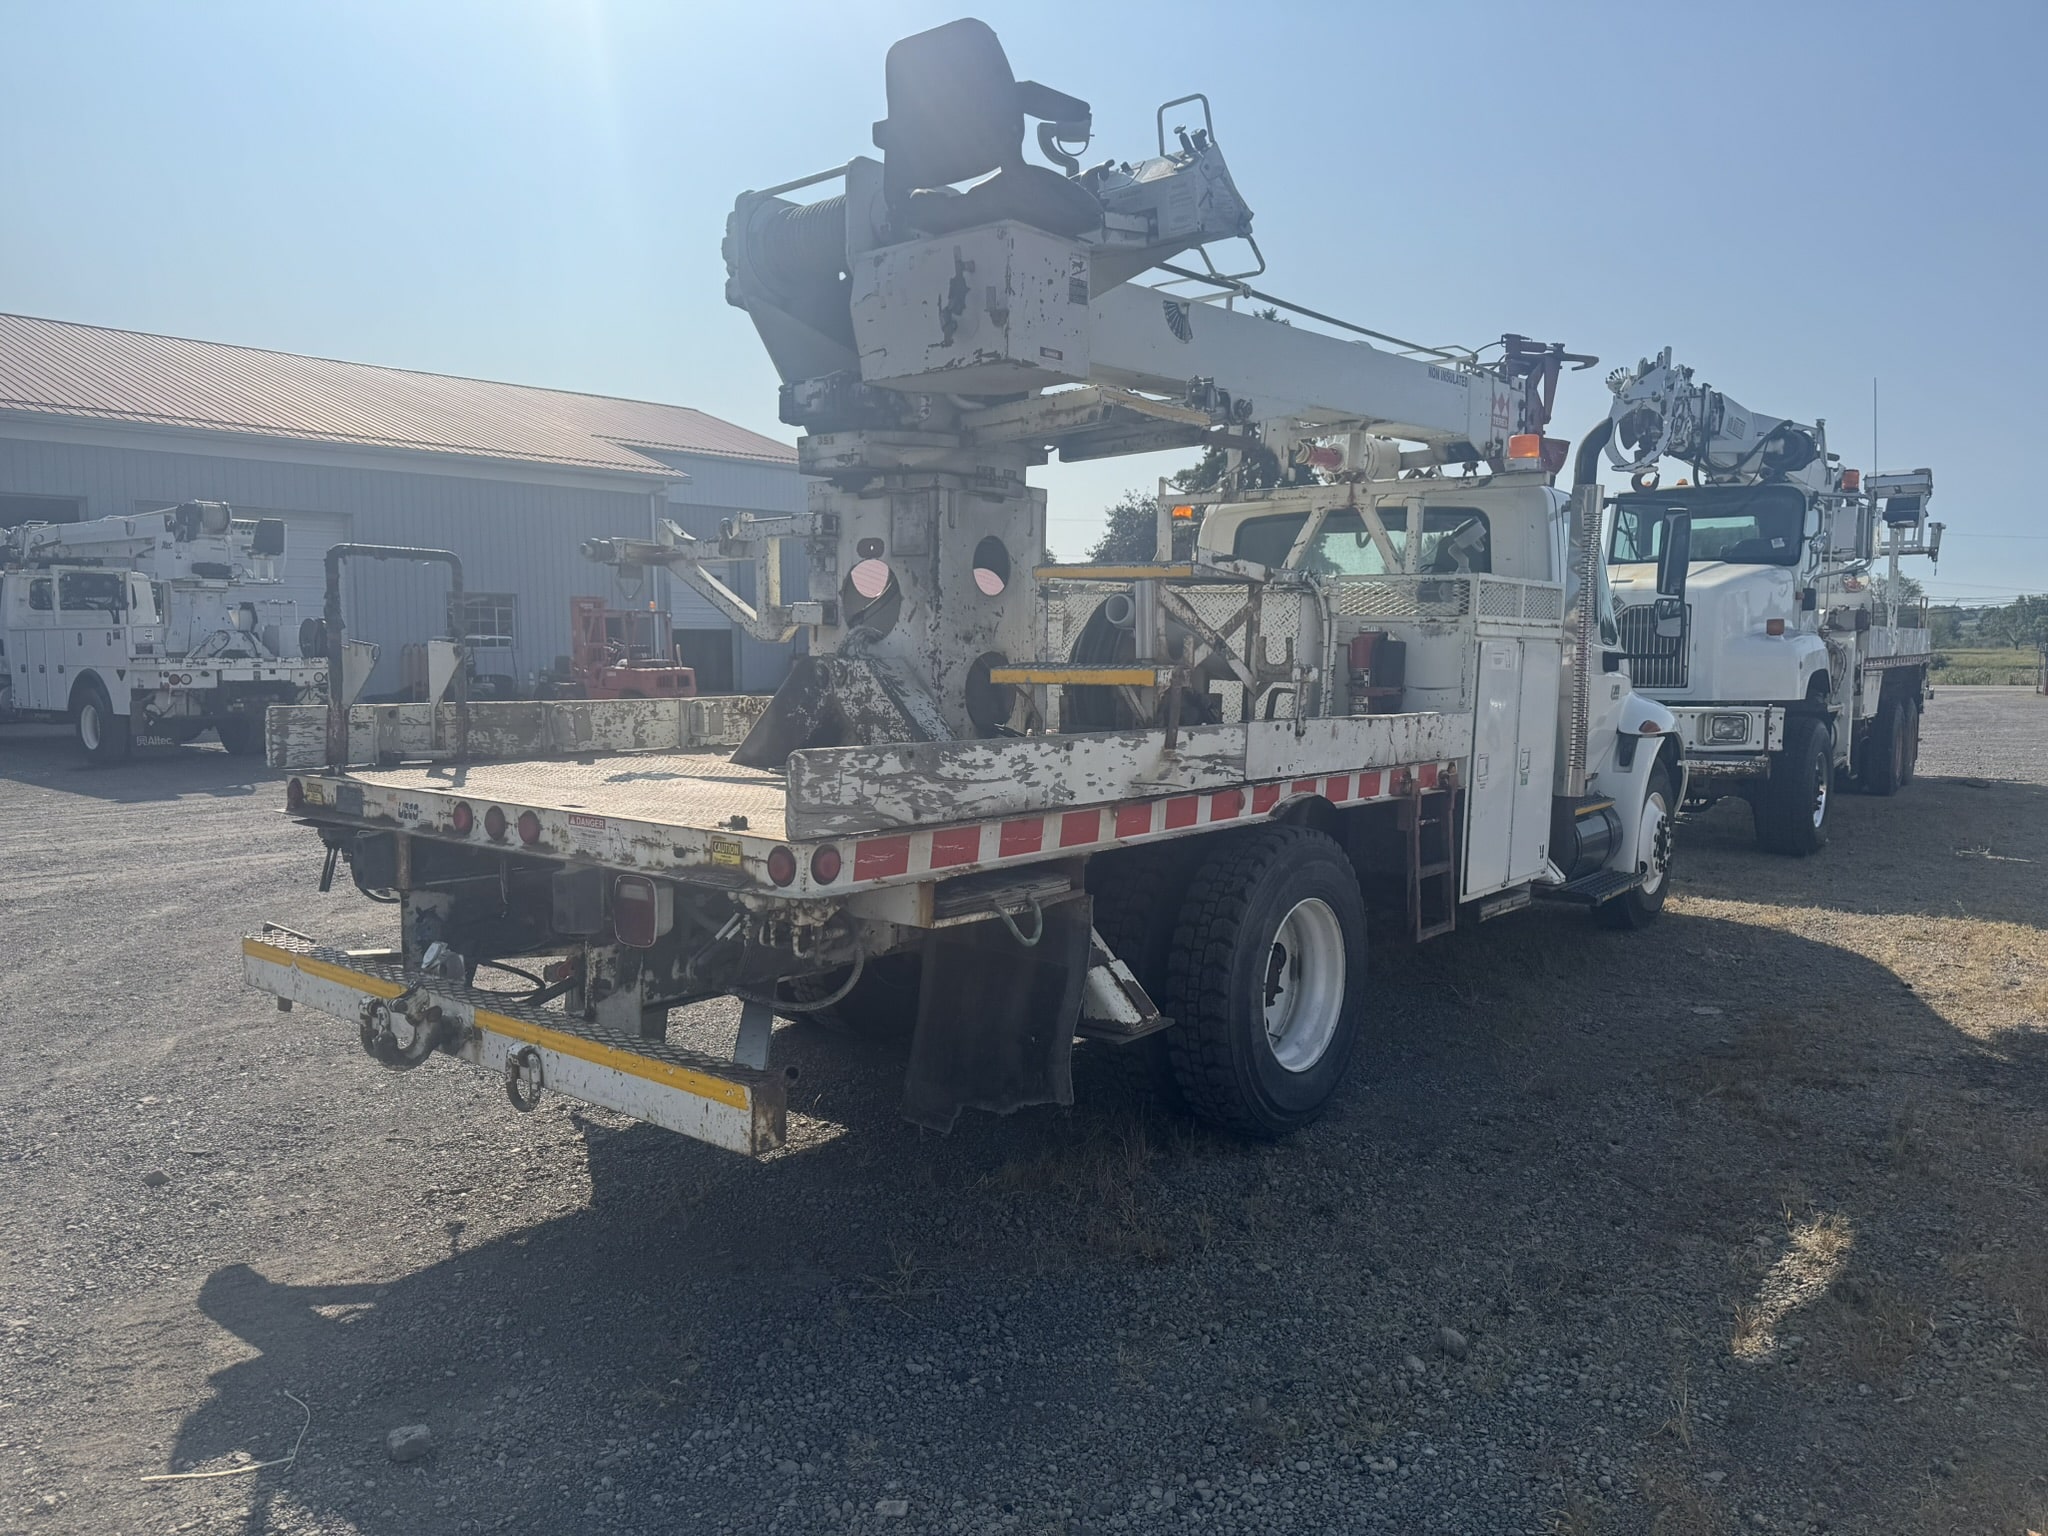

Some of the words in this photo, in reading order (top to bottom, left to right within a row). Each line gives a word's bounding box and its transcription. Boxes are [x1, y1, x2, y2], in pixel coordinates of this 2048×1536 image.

[1428, 366, 1440, 381] NON
[148, 735, 173, 745] Altec
[576, 816, 605, 829] DANGER
[714, 842, 739, 855] CAUTION
